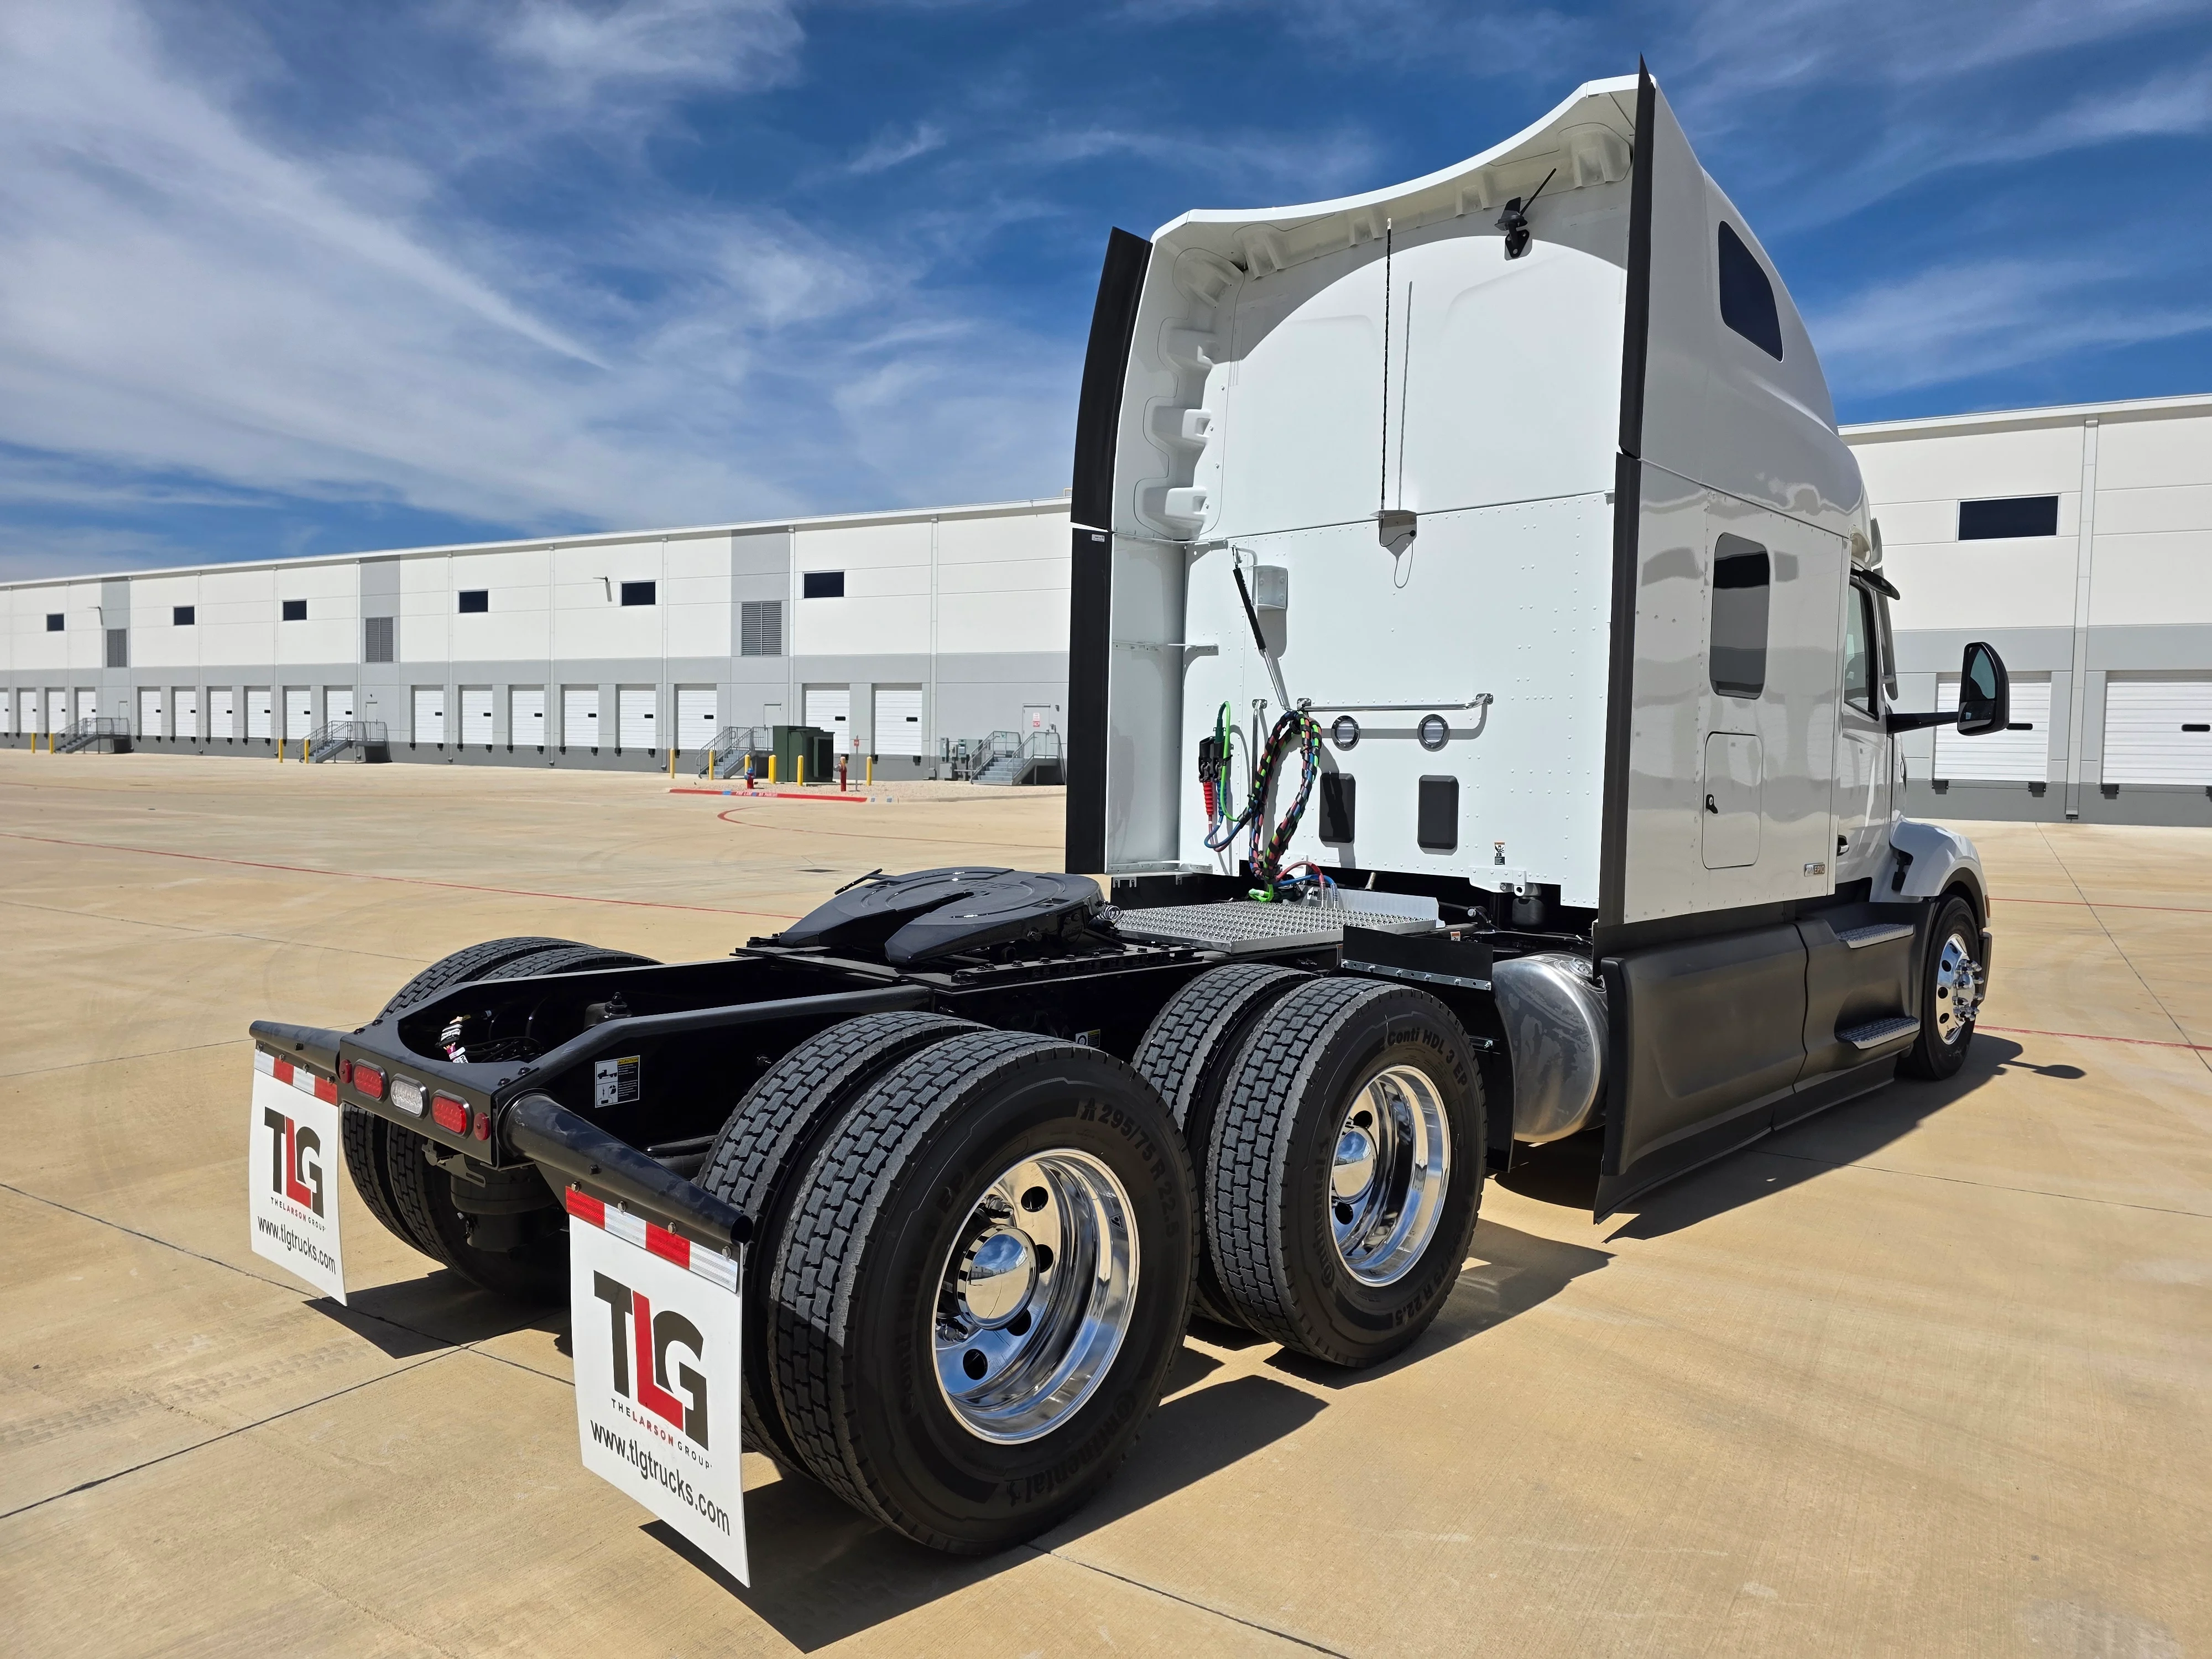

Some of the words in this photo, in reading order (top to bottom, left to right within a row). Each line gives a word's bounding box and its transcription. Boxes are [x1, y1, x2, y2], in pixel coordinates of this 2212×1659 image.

[1387, 1026, 1421, 1047] Conti
[1422, 1029, 1446, 1056] HDL
[1446, 1048, 1455, 1064] 3
[1453, 1061, 1468, 1086] EP
[1098, 1104, 1157, 1161] 295/75
[264, 1106, 325, 1219] TLG
[1149, 1158, 1166, 1182] R
[308, 1217, 325, 1232] GROUP
[1157, 1181, 1180, 1238] 22.5
[1313, 1159, 1335, 1289] Continental
[257, 1215, 336, 1275] www.tlgtrucks.com
[1395, 1293, 1423, 1326] 22.5
[1423, 1283, 1434, 1301] R
[593, 1270, 709, 1451] TLG
[677, 1441, 709, 1469] GROUP
[1025, 1389, 1137, 1504] Continental
[590, 1420, 730, 1536] www.tlgtrucks.com
